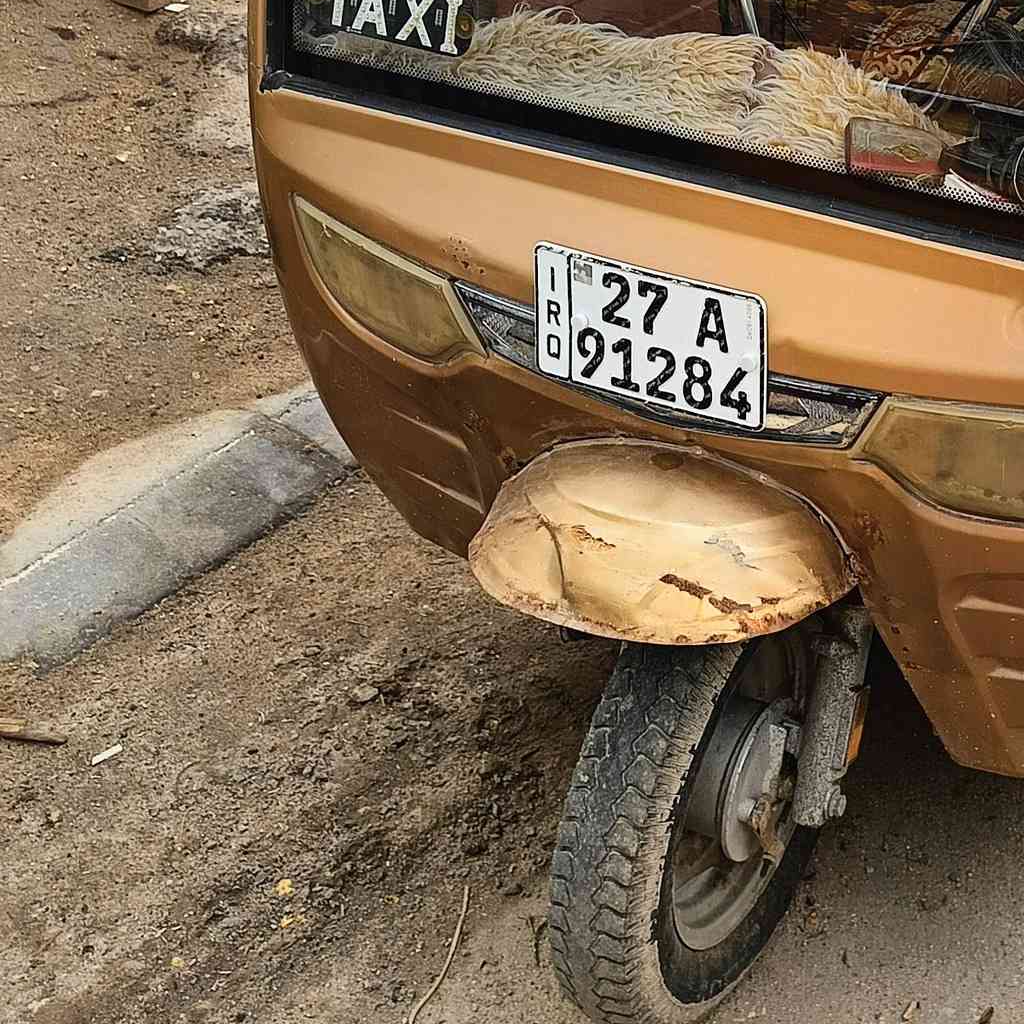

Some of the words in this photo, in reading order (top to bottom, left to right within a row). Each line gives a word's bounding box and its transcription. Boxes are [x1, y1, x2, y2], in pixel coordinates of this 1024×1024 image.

[546, 266, 561, 360] IRQ
[601, 272, 668, 335] 27
[695, 297, 728, 353] A
[576, 327, 751, 420] 91284
